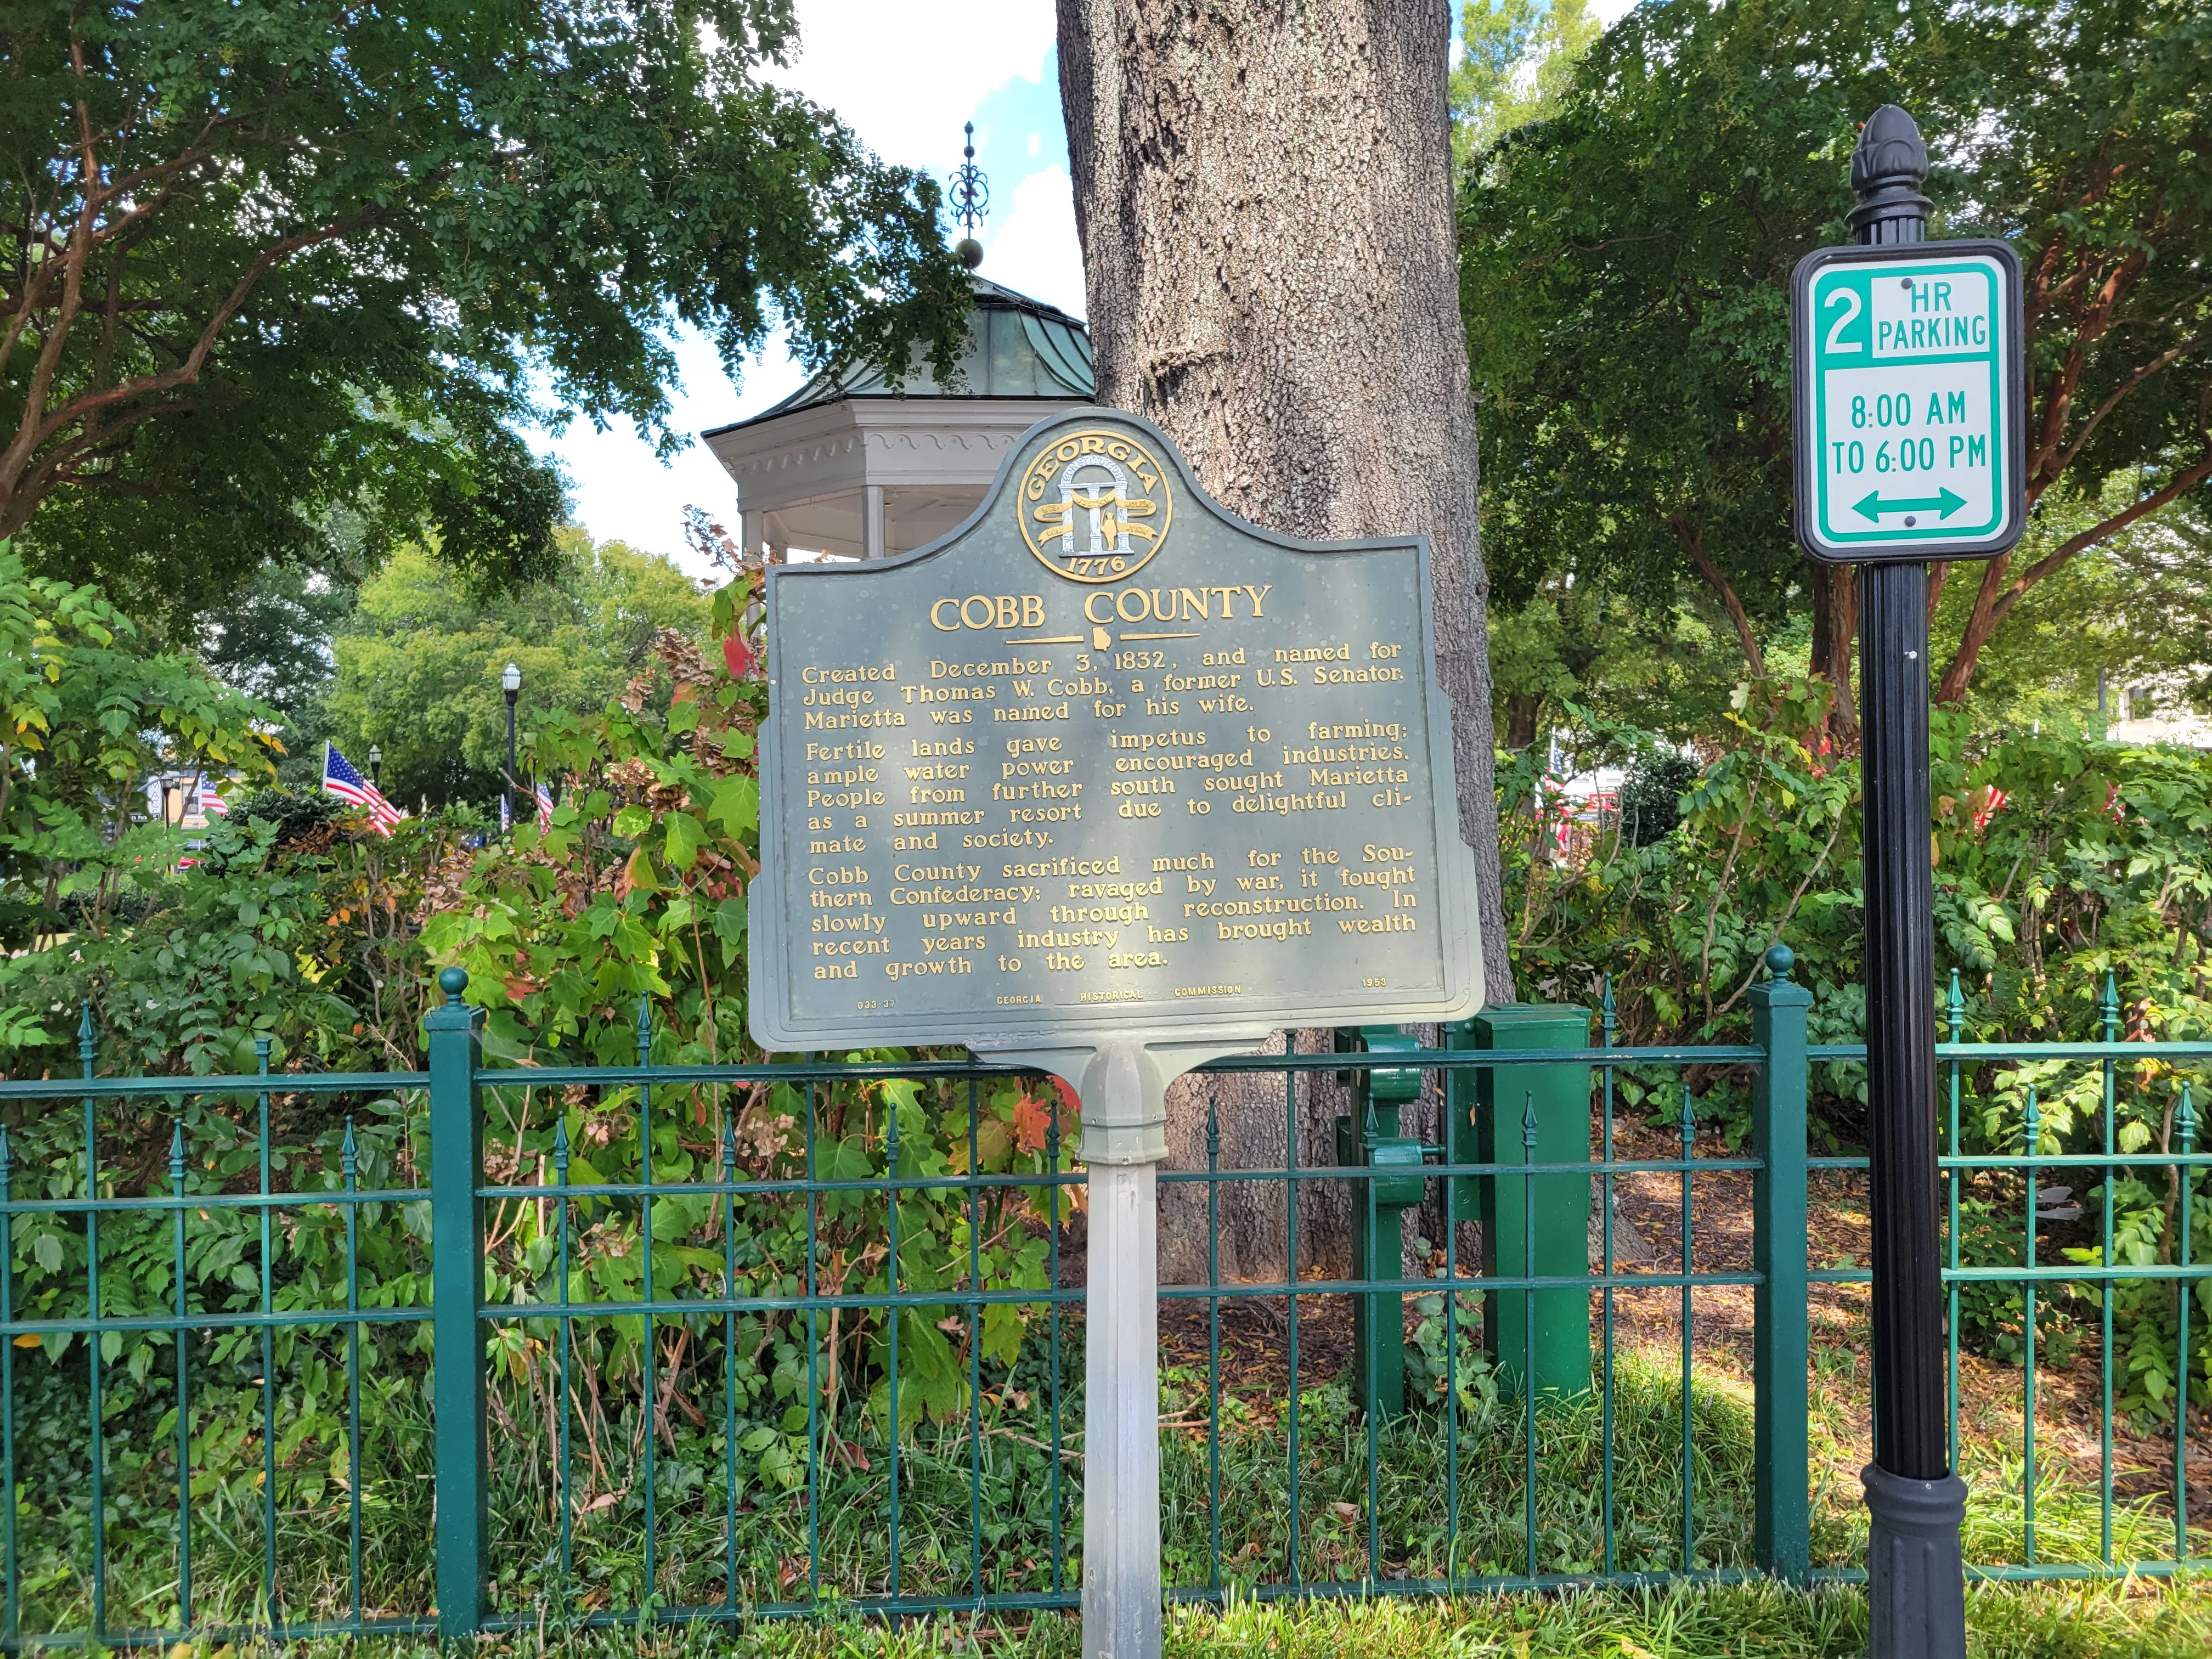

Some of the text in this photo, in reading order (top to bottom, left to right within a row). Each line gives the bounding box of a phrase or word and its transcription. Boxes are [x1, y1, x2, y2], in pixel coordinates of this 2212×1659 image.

[1911, 282, 1952, 313] HR
[1824, 287, 1863, 354] 2
[1879, 315, 1986, 351] PARKING
[1852, 391, 1966, 429] 8:00 AM
[1028, 437, 1158, 501] GEORGIA
[1832, 434, 1986, 474] TO 6:00 PM
[1066, 556, 1126, 575] 1776
[930, 584, 1272, 632] COBB COUNTY
[802, 642, 1401, 685] Created December 3, 1832, and named for
[803, 665, 1403, 709] Judge Thomas W. Cobb, a former U.S. Senator.
[805, 693, 1254, 731] Marietta was named for his wife.
[806, 718, 1407, 761] Fertile lands gave impetus to farming;
[808, 745, 1409, 787] ample water power encouraged industries.
[808, 766, 1409, 809] People from further south sought Marietta
[808, 787, 1412, 831] as a summer resort due to delightful cli-
[810, 828, 1053, 854] mate and society.
[809, 844, 1413, 885] Cobb County sacrificed much for the Sou-
[810, 867, 1415, 908] thern Confederacy; ravaged by war, it fought
[812, 889, 1416, 934] slowly upward through reconstruction. In
[812, 914, 1415, 956] recent years industry has brought wealth
[813, 952, 1167, 981] and growth to the area.
[1362, 978, 1387, 988] 1953
[857, 1000, 895, 1009] 033-37
[996, 985, 1241, 1005] GEORGIA HISTORICAL COMMISSION
